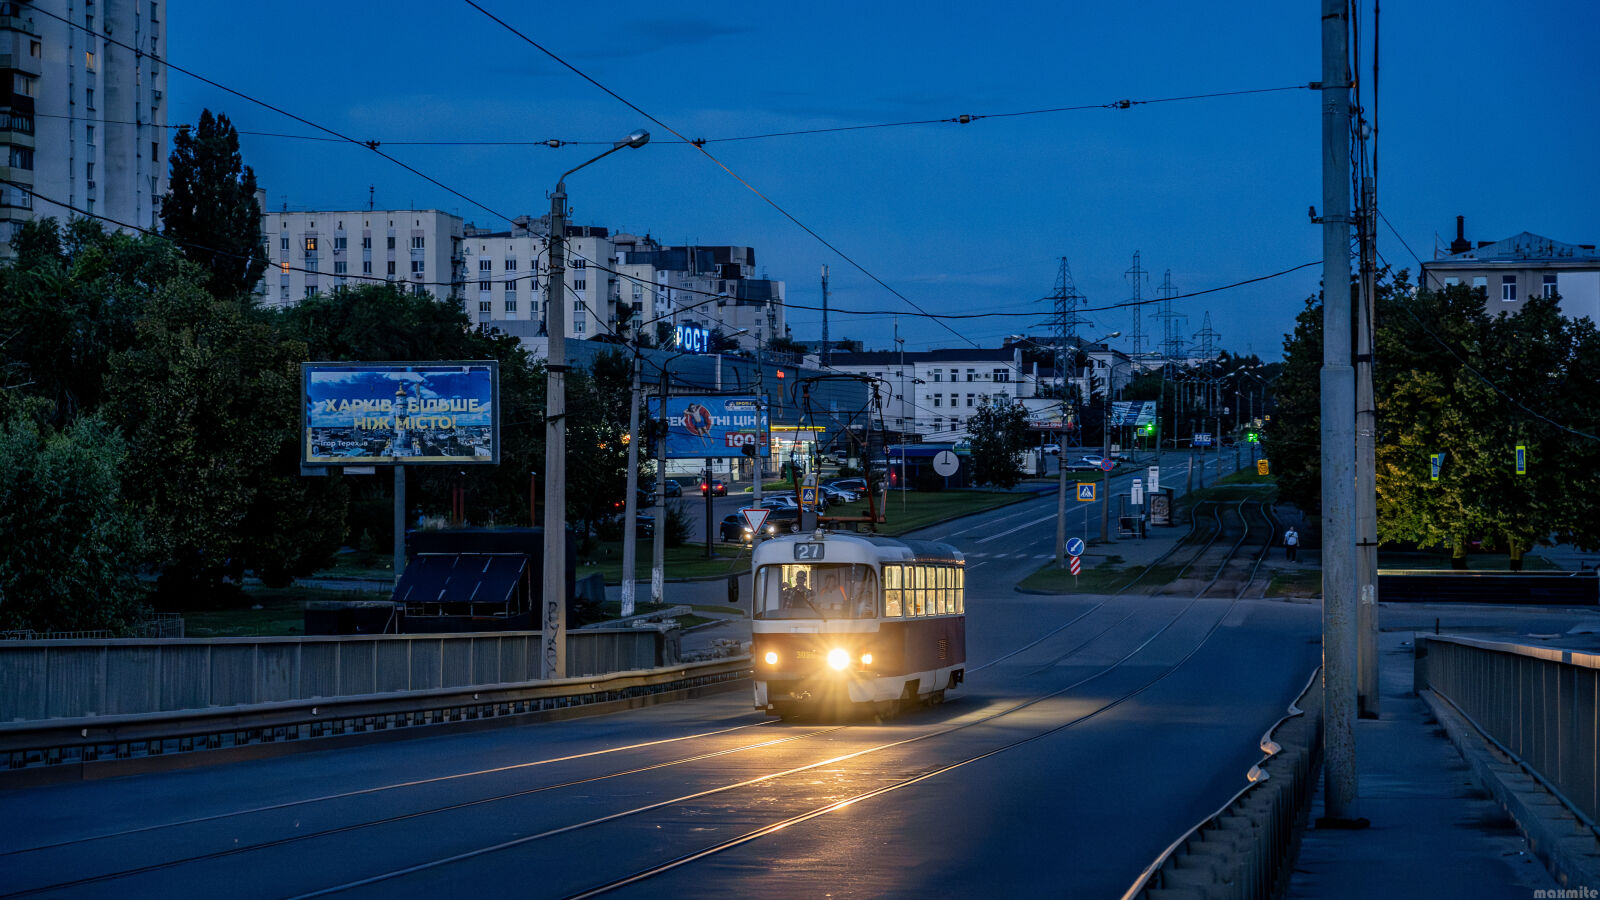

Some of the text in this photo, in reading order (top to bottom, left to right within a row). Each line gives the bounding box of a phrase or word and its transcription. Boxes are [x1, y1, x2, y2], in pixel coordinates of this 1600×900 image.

[676, 325, 709, 352] РОСТ
[325, 398, 392, 412] ХАРКІВ
[354, 416, 457, 430] НІЖ МІСТО!
[798, 544, 819, 559] 27
